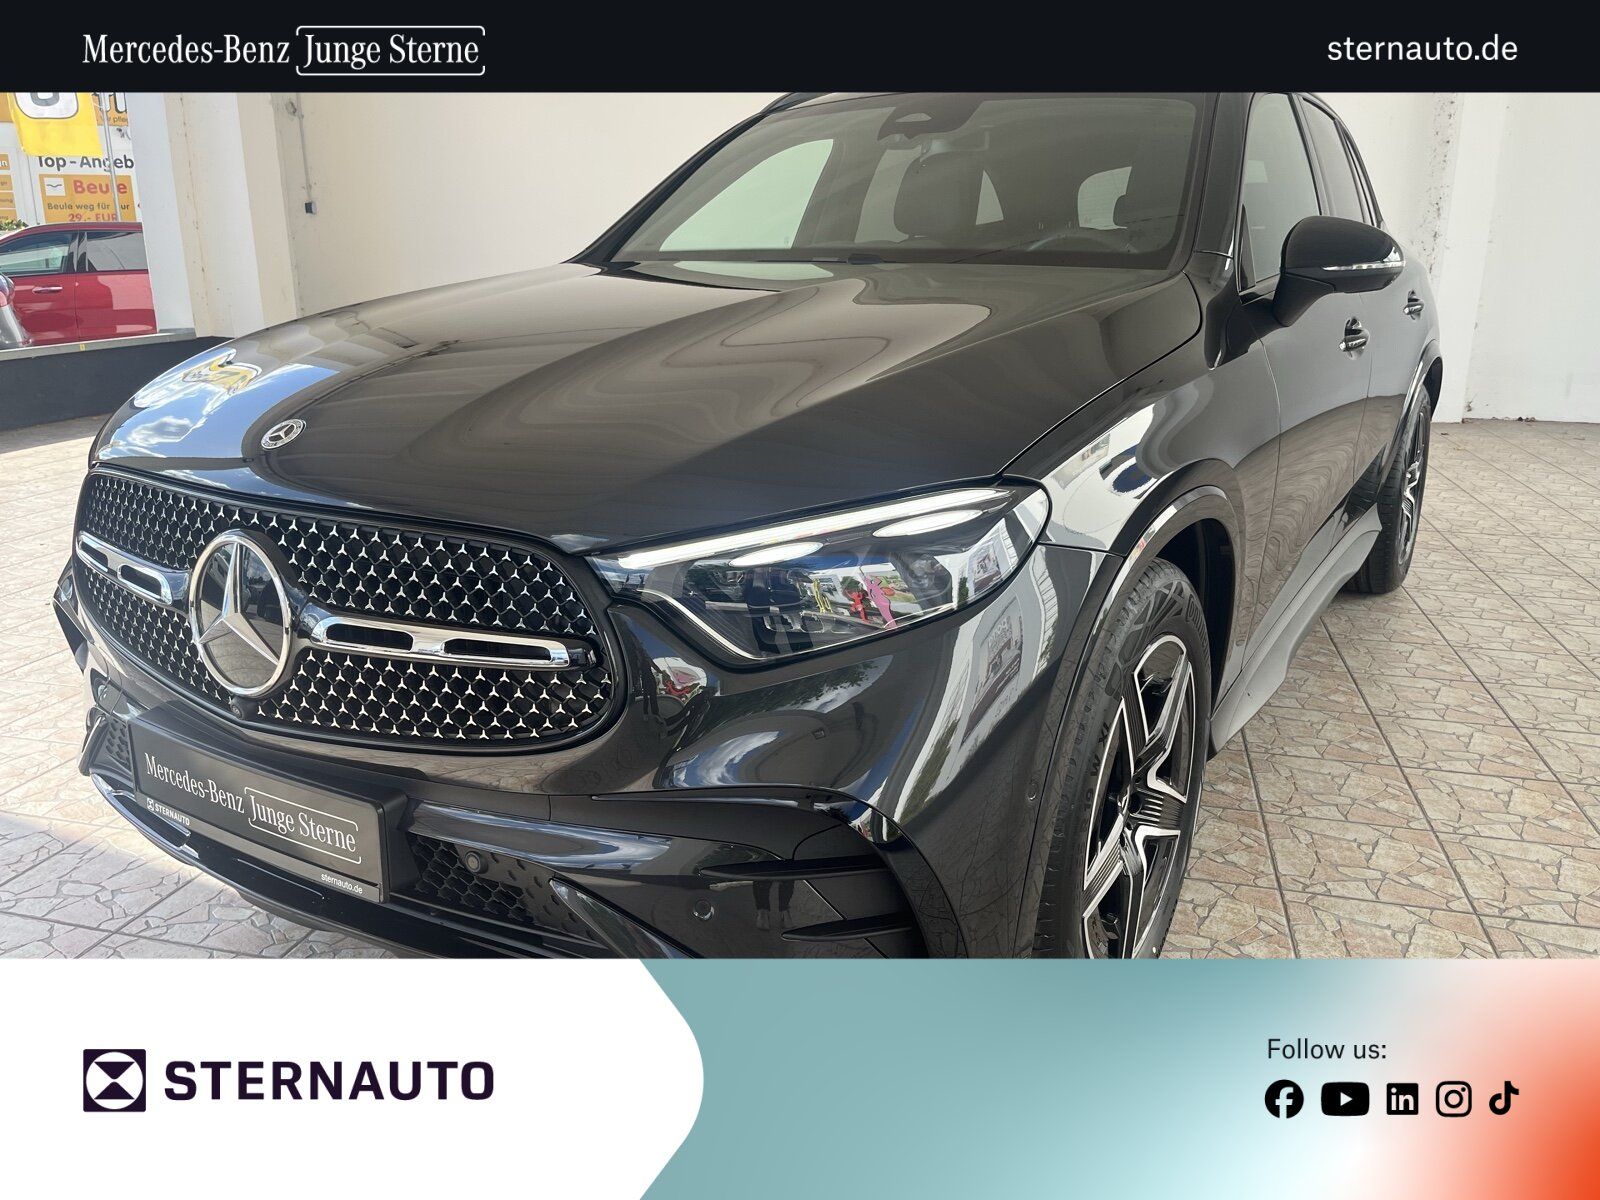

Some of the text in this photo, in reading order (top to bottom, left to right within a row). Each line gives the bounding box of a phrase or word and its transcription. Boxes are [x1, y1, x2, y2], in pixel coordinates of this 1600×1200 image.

[73, 179, 128, 195] Beue
[47, 202, 73, 210] Beule
[75, 204, 95, 212] weg
[97, 202, 111, 210] für
[144, 752, 356, 853] Mercedes-Benz Junge Sterne
[154, 803, 191, 826] STERNAUTO
[320, 873, 363, 894] sternauto.de
